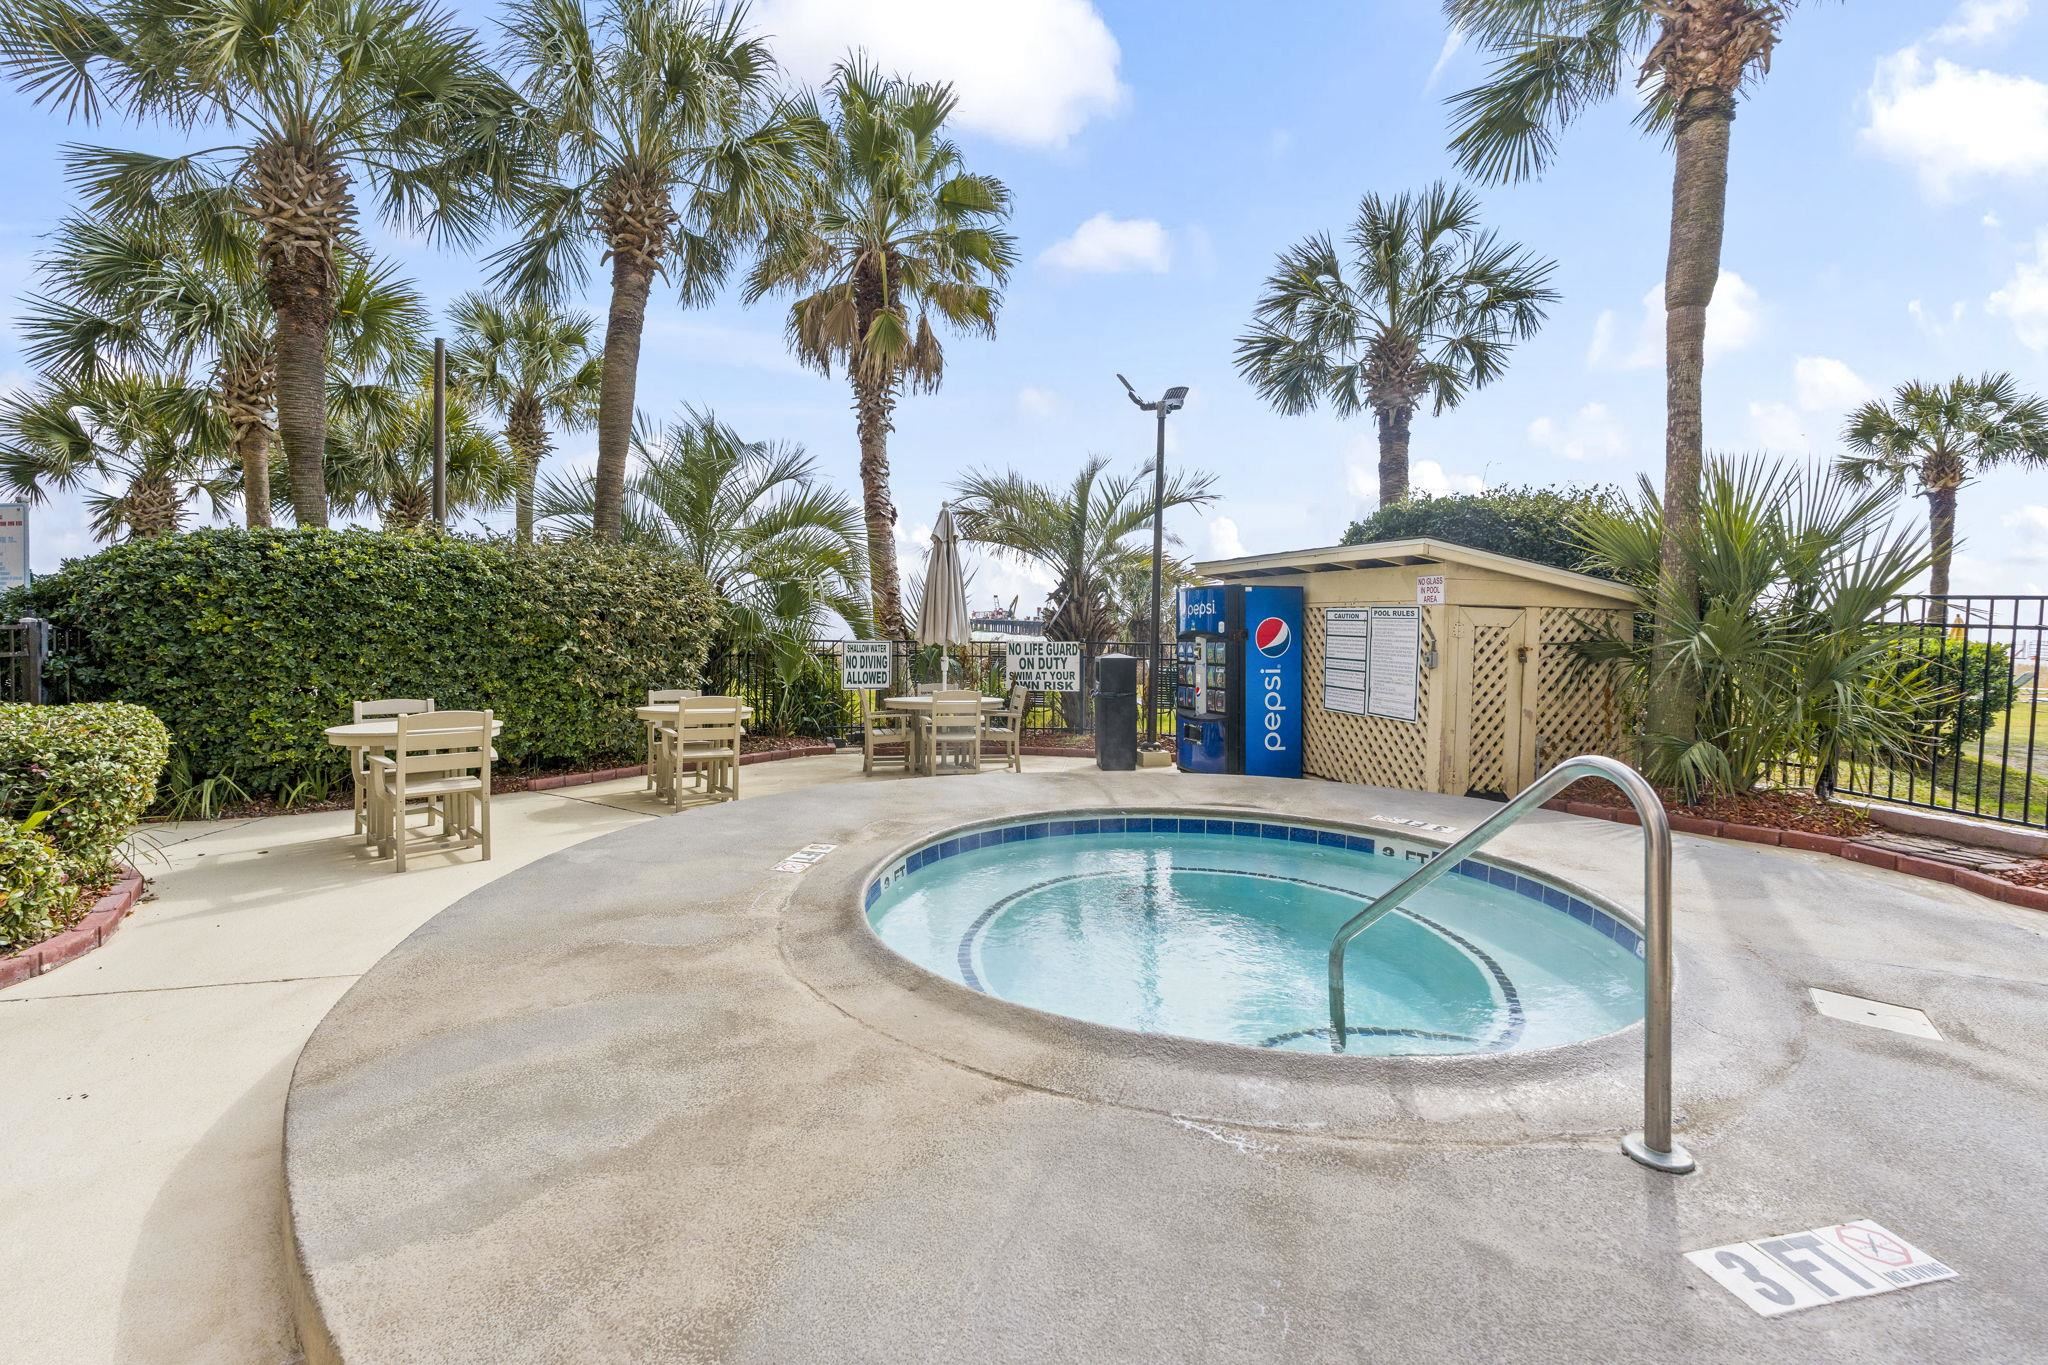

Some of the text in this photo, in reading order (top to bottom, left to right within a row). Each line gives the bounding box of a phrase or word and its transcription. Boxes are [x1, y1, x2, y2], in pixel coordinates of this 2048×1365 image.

[1418, 577, 1443, 586] NO GLASS
[1426, 586, 1441, 594] POOL
[1423, 595, 1438, 603] AREA
[1187, 600, 1216, 619] pepsi
[1333, 612, 1360, 620] CAUTION
[847, 644, 887, 653] SHALLOW WATER
[1008, 642, 1078, 656] NO LIFE GUARD
[845, 655, 888, 669] NO DIVING
[1018, 657, 1068, 670] ON DUTY
[846, 671, 888, 685] ALLOWED
[1035, 671, 1047, 681] AT
[1049, 671, 1076, 681] YOUR
[1044, 681, 1074, 690] RISK
[1260, 664, 1286, 751] pepsi
[1405, 850, 1430, 865] FT
[893, 864, 906, 881] FT
[1714, 1234, 1877, 1306] 3 FT
[1881, 1262, 1952, 1284] NO DIVING
